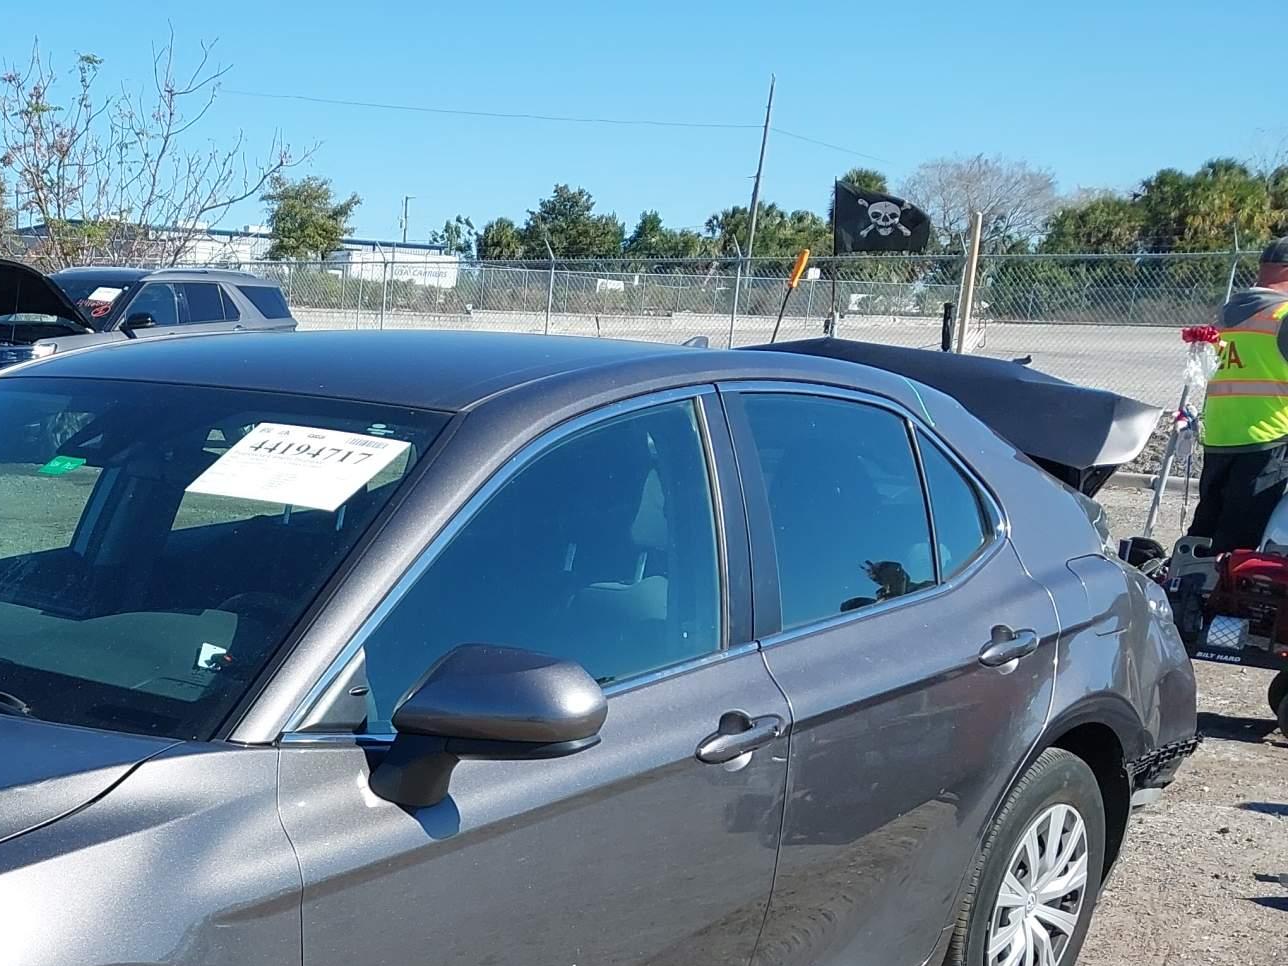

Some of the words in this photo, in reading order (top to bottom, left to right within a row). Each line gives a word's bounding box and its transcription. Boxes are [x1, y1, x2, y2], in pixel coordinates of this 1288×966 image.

[249, 439, 374, 465] 44194717
[1196, 651, 1217, 659] BILT
[1216, 654, 1241, 662] HARD
